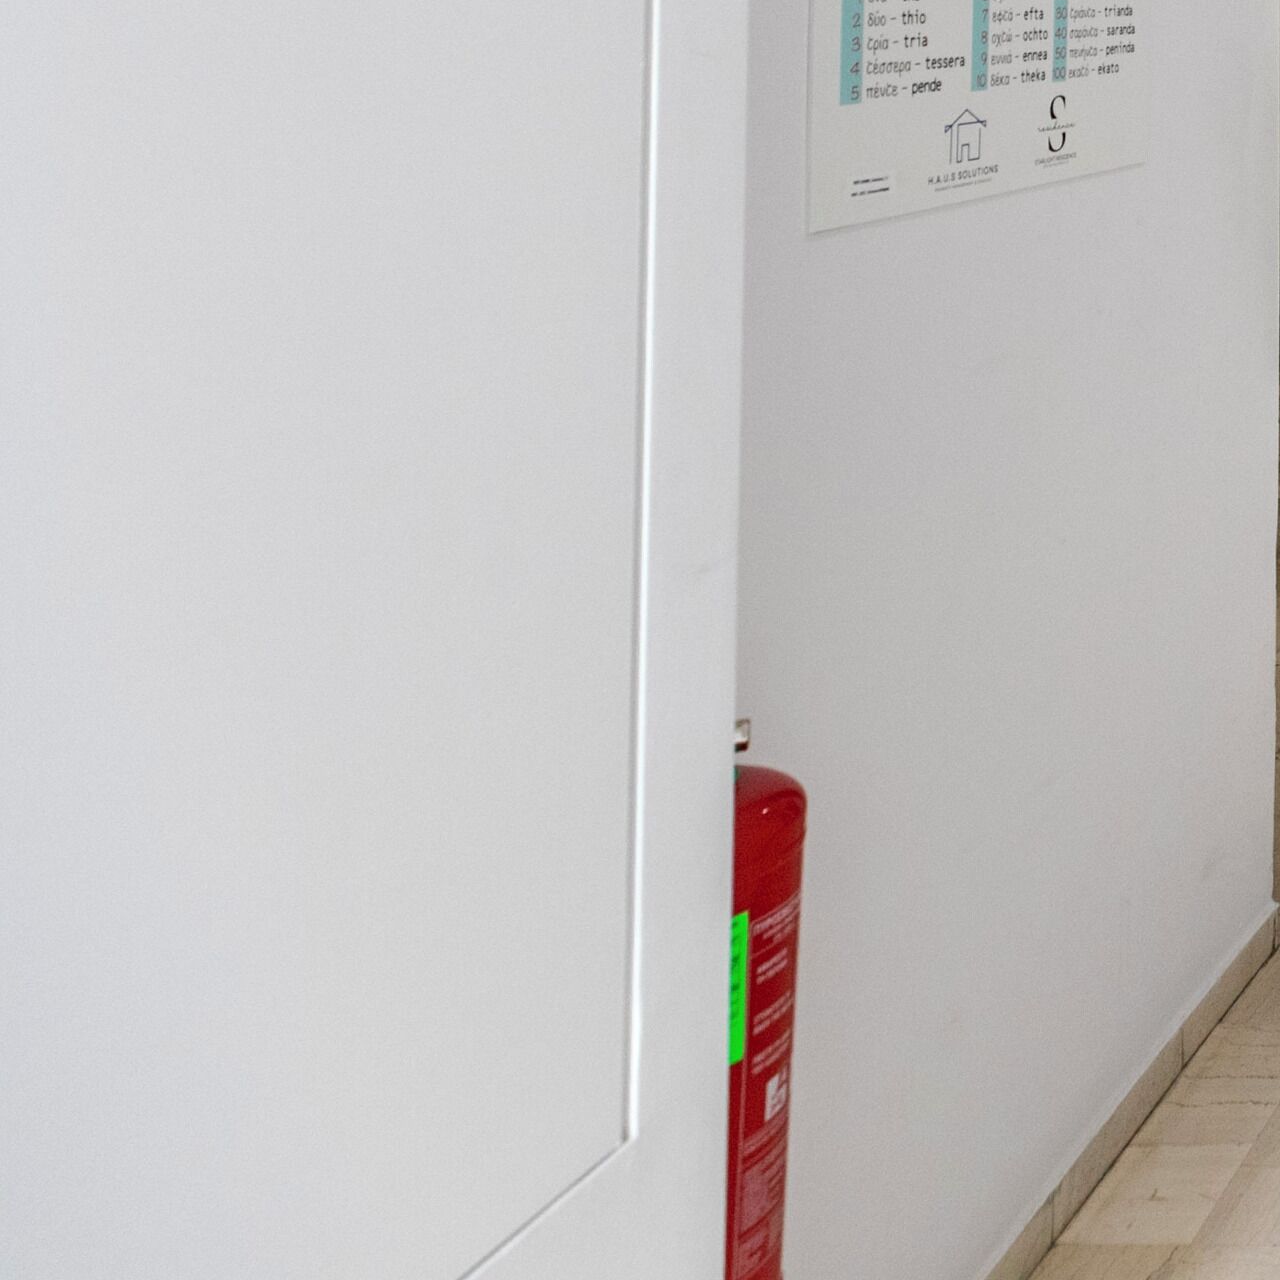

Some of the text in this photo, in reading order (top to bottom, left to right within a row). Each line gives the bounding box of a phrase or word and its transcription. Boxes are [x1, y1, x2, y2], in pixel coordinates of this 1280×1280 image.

[1023, 7, 1044, 20] efta
[1104, 4, 1133, 17] trianda
[851, 12, 862, 28] 2
[901, 9, 926, 25] thio
[1023, 27, 1048, 41] ochto
[1107, 24, 1135, 36] saranda
[904, 32, 928, 48] tria
[1106, 41, 1135, 56] peninda
[1022, 50, 1047, 62] ennea
[849, 61, 861, 76] 4
[925, 56, 965, 69] tessera
[1097, 63, 1119, 75] ekato
[1021, 69, 1045, 83] theka
[912, 78, 942, 95] pende
[958, 164, 998, 180] SOLUTIONS
